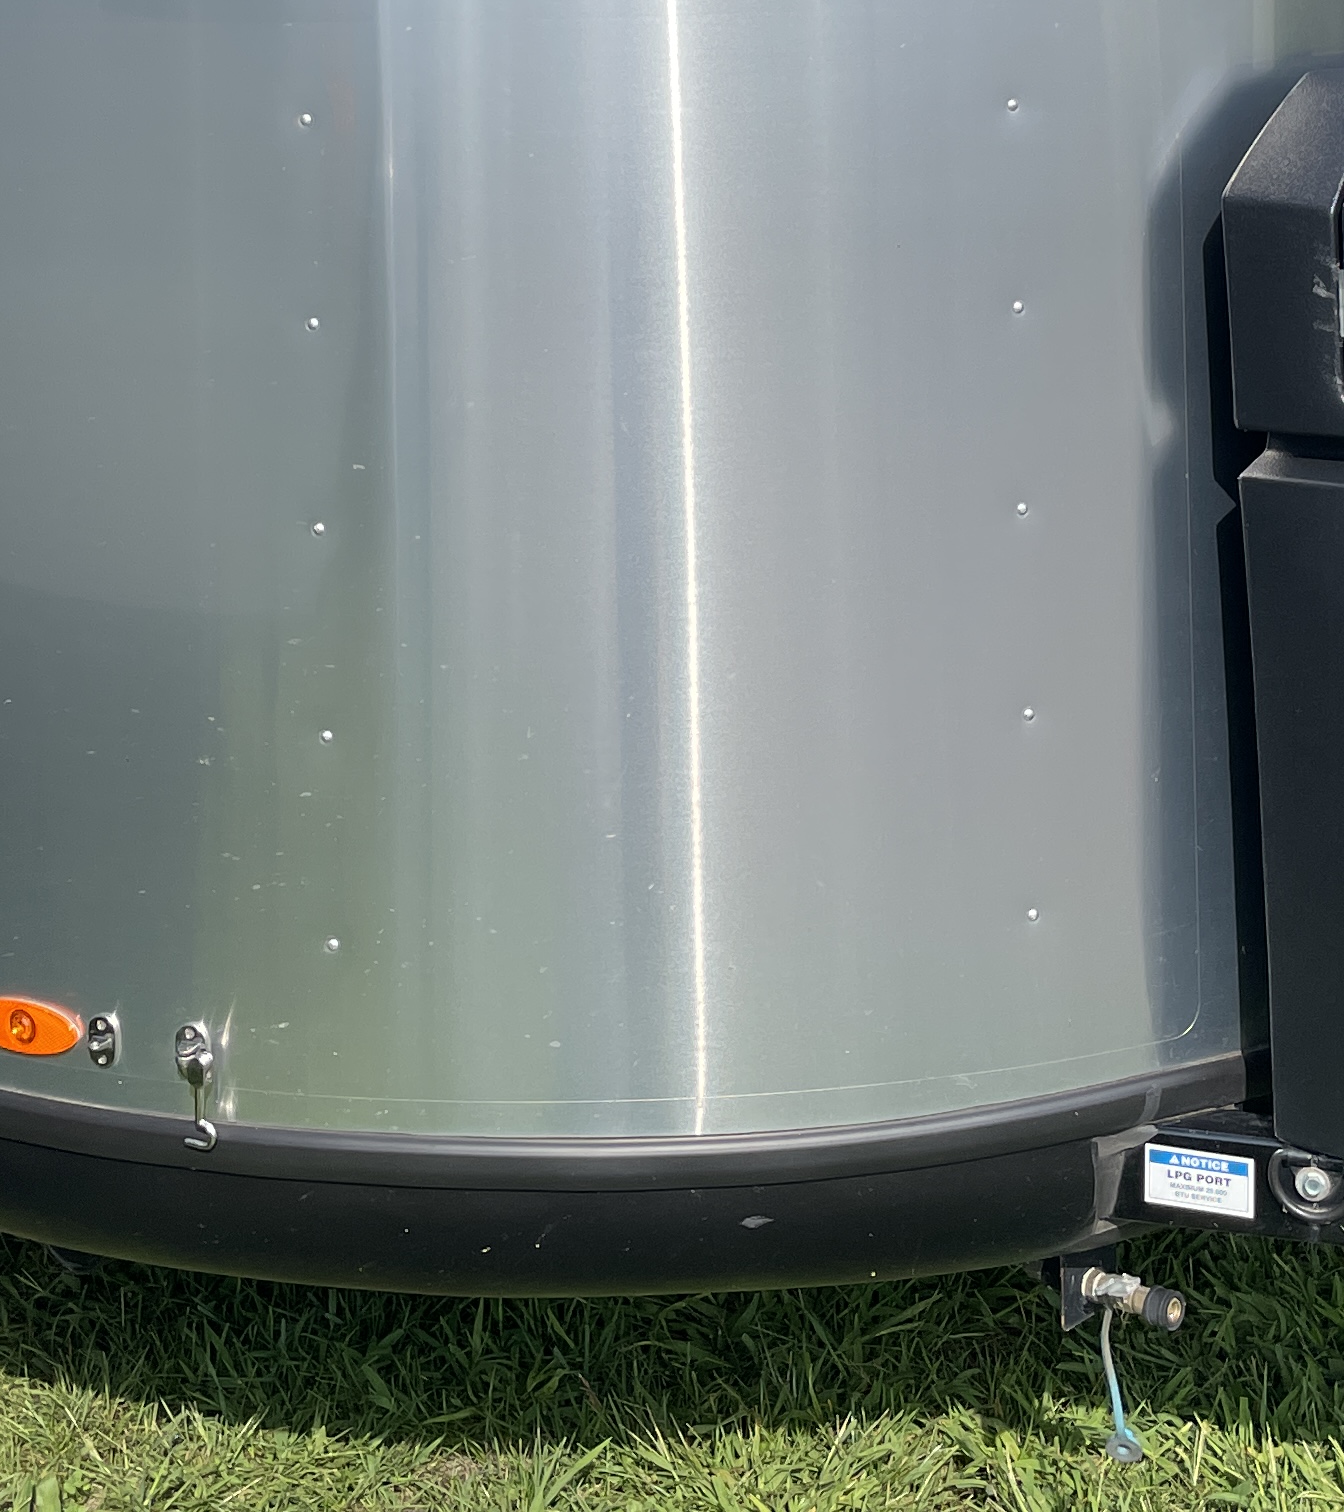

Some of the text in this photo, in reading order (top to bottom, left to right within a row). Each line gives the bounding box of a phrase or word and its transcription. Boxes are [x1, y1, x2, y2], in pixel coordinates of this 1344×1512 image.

[1181, 1155, 1230, 1172] NOTICE
[1167, 1169, 1232, 1188] LPG PORT
[1169, 1182, 1205, 1193] MAXIMUM
[1191, 1193, 1223, 1204] SERVICE
